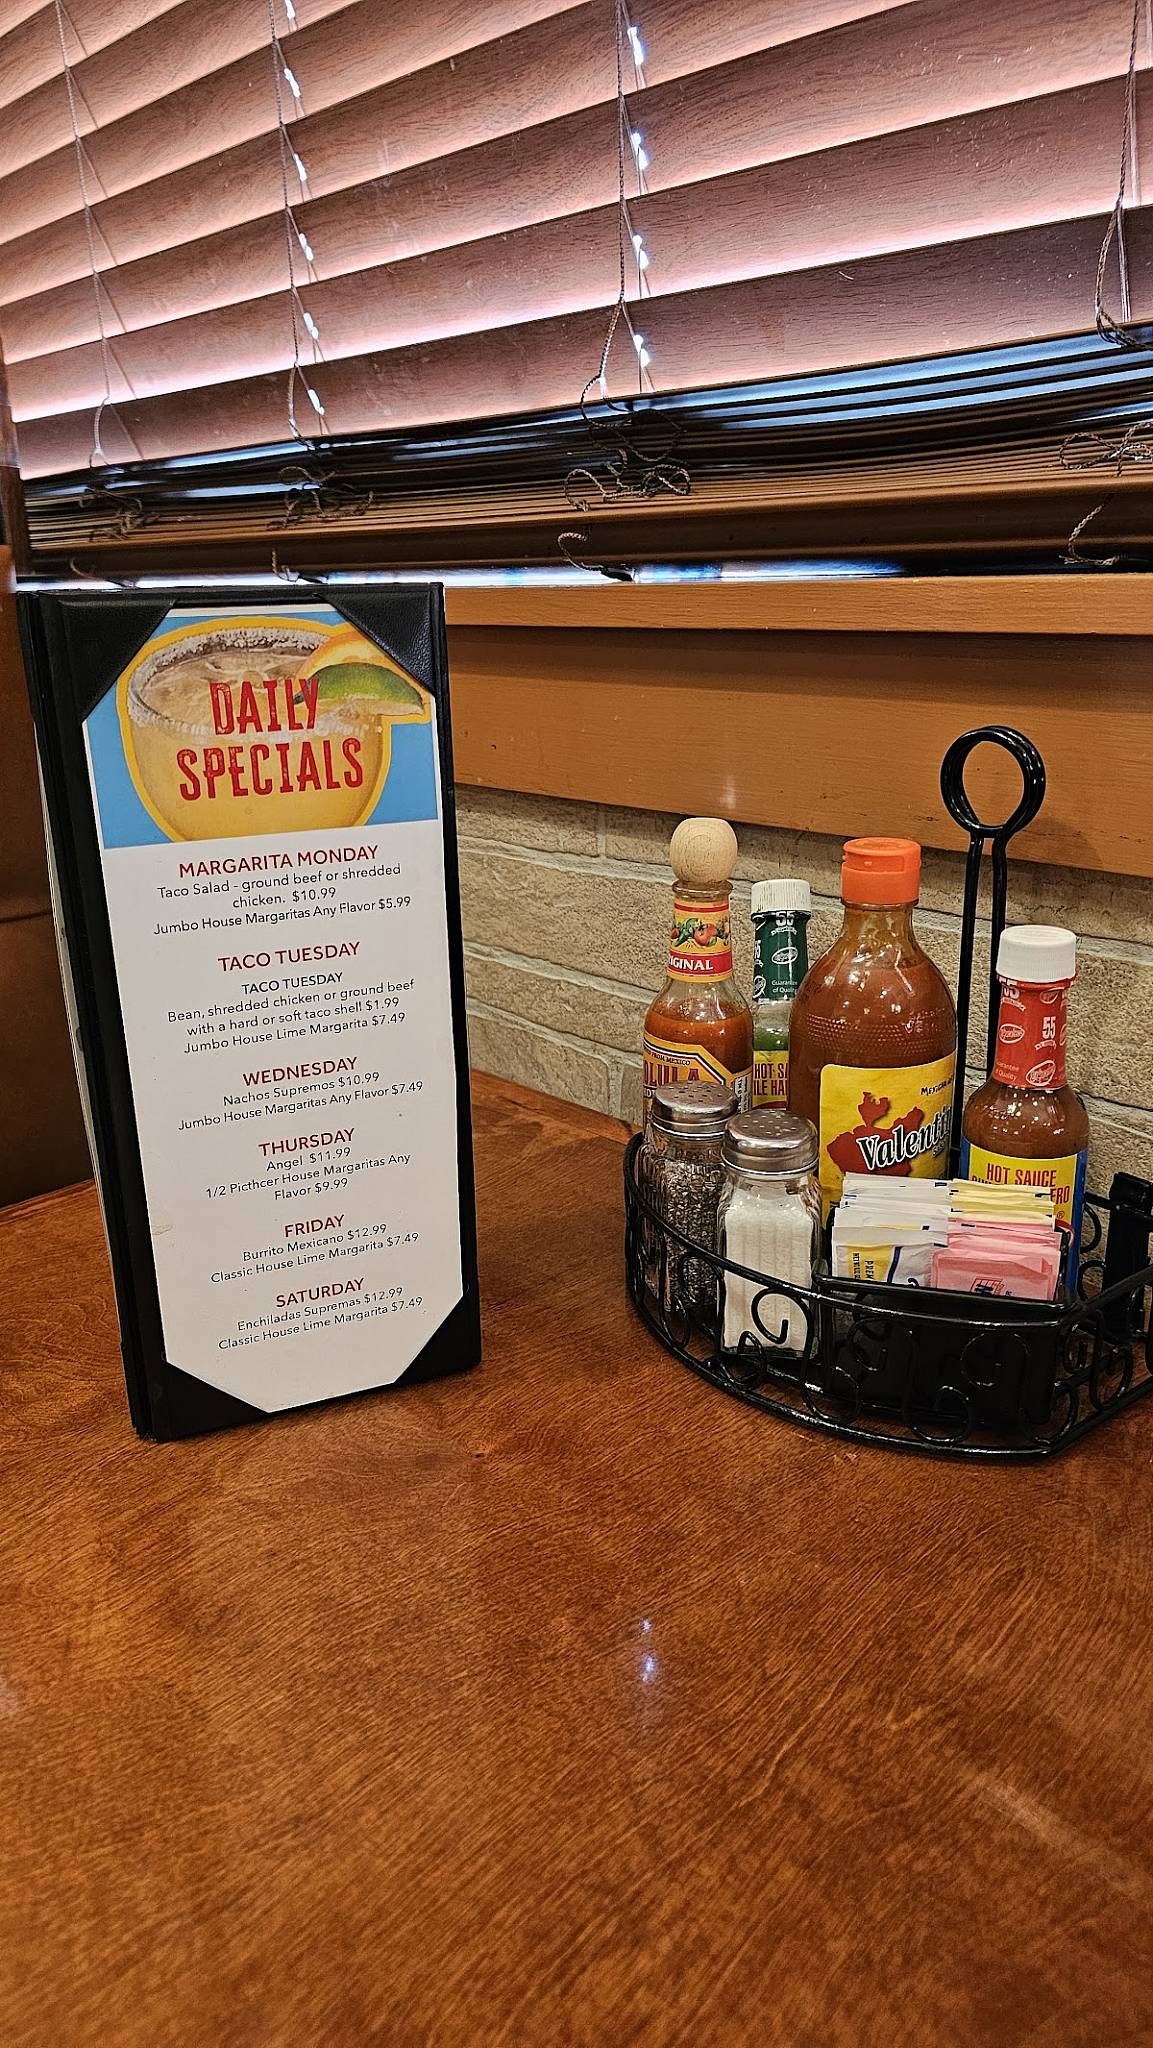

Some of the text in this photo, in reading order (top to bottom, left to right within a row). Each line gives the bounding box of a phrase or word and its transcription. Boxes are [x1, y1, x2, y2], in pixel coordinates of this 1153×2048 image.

[209, 678, 319, 735] DAILY
[177, 738, 363, 801] SPECIALS
[179, 845, 378, 878] MARGARITA MONDAY
[157, 887, 188, 898] Taco
[194, 881, 229, 894] Salad
[242, 875, 289, 892] ground
[293, 871, 322, 884] beef
[326, 872, 338, 881] or
[342, 864, 400, 880] shredded
[233, 887, 336, 908] chicken. $10.99
[154, 897, 410, 935] Jumbo House Margaritas Any Flavor $5.99
[218, 942, 360, 971] TACO TUESDAY
[669, 955, 713, 971] IGINAL
[242, 972, 343, 995] TACO TUESDAY
[168, 979, 415, 1022] Bean, shredded chicken or ground beef
[187, 1023, 214, 1036] with
[229, 1017, 258, 1030] hard
[262, 1017, 275, 1026] or
[279, 1011, 301, 1023] soft
[305, 1008, 331, 1019] taco
[334, 1003, 362, 1015] shell
[365, 998, 399, 1011] $1.99
[184, 1013, 405, 1053] Jumbo House Lime Margarita $7.49
[1042, 1016, 1056, 1039] 55
[243, 1057, 357, 1086] WEDNESDAY
[754, 1063, 774, 1079] HOT
[178, 1081, 423, 1130] Jumbo House Margaritas Any Flavor $7.49
[223, 1072, 379, 1106] Nachos Supremos $10.99
[259, 1128, 354, 1156] THURSDAY
[267, 1147, 350, 1172] Angel $11.99
[987, 1163, 1011, 1184] HOT
[1015, 1169, 1057, 1188] SAUCE
[206, 1154, 410, 1199] 1/2 Picthcer House Margaritas Any
[275, 1178, 348, 1200] Flavor $9.99
[243, 1224, 386, 1261] Burrito Mexicano $12.99
[284, 1215, 344, 1238] FRIDAY
[211, 1233, 419, 1283] Classic House Lime Margarita $7.49
[238, 1288, 402, 1330] Enchiladas Supremas $12.99
[276, 1278, 364, 1307] SATURDAY
[219, 1297, 423, 1349] Classic House Lime Margarita $7.49
